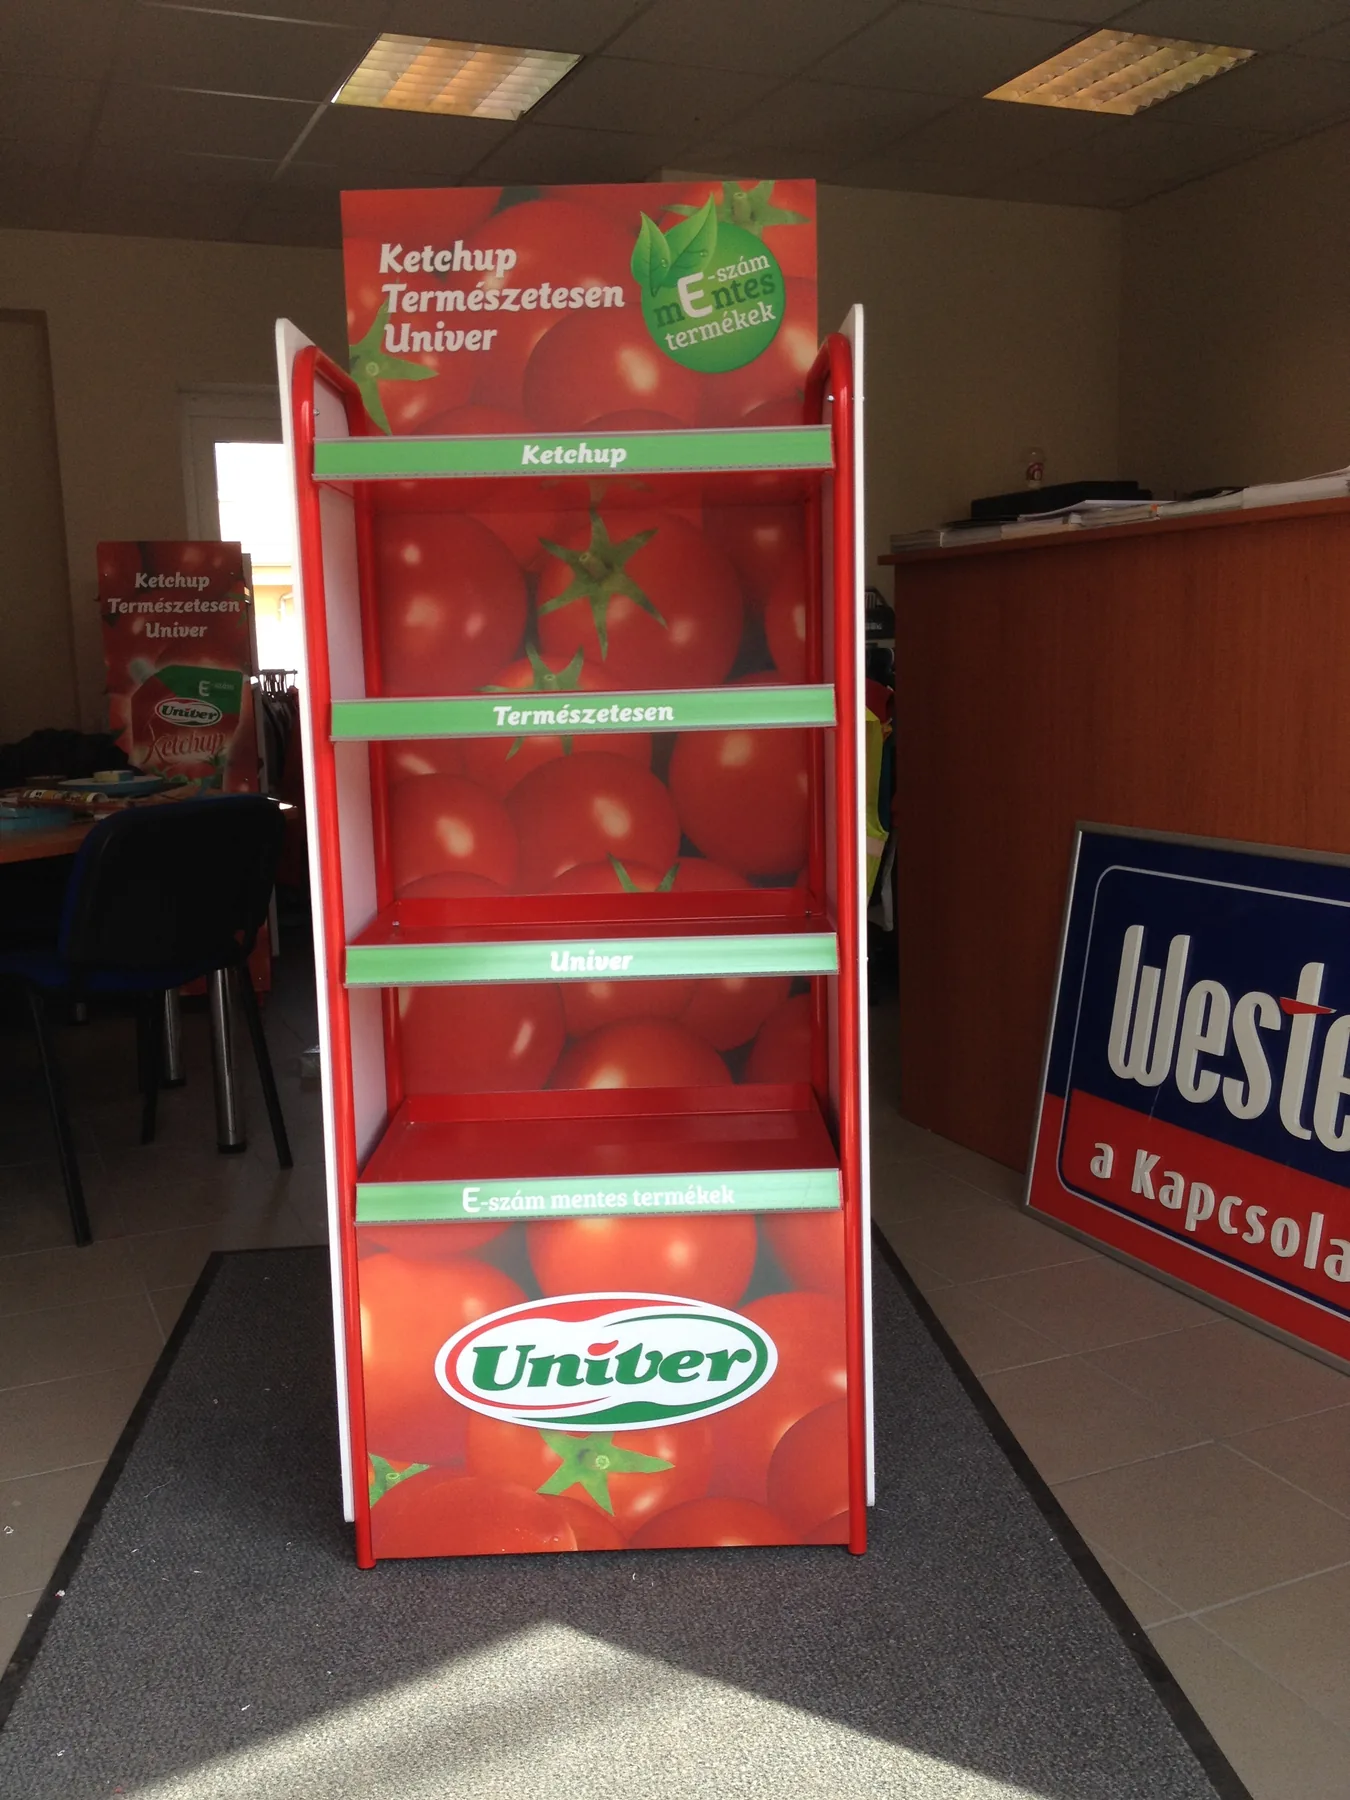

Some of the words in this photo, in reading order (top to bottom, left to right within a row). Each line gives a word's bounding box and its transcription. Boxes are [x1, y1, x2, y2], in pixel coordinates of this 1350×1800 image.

[379, 240, 517, 277] Ketchup
[382, 281, 625, 313] Természetesen
[384, 322, 498, 353] Univer
[665, 301, 776, 351] termékek
[521, 443, 627, 468] Ketchup
[135, 572, 210, 591] Ketchup
[107, 598, 240, 614] Természetesen
[145, 622, 208, 638] Univer
[162, 705, 217, 720] Univer
[493, 704, 674, 726] Természetesen
[143, 727, 225, 764] Ketchup
[551, 948, 633, 972] Univer
[462, 1187, 545, 1213] E-szám
[551, 1190, 627, 1209] mentes
[633, 1184, 735, 1207] termékek
[1090, 1142, 1114, 1179] a
[1131, 1148, 1350, 1284] Kapcsola
[473, 1340, 752, 1392] Univer
